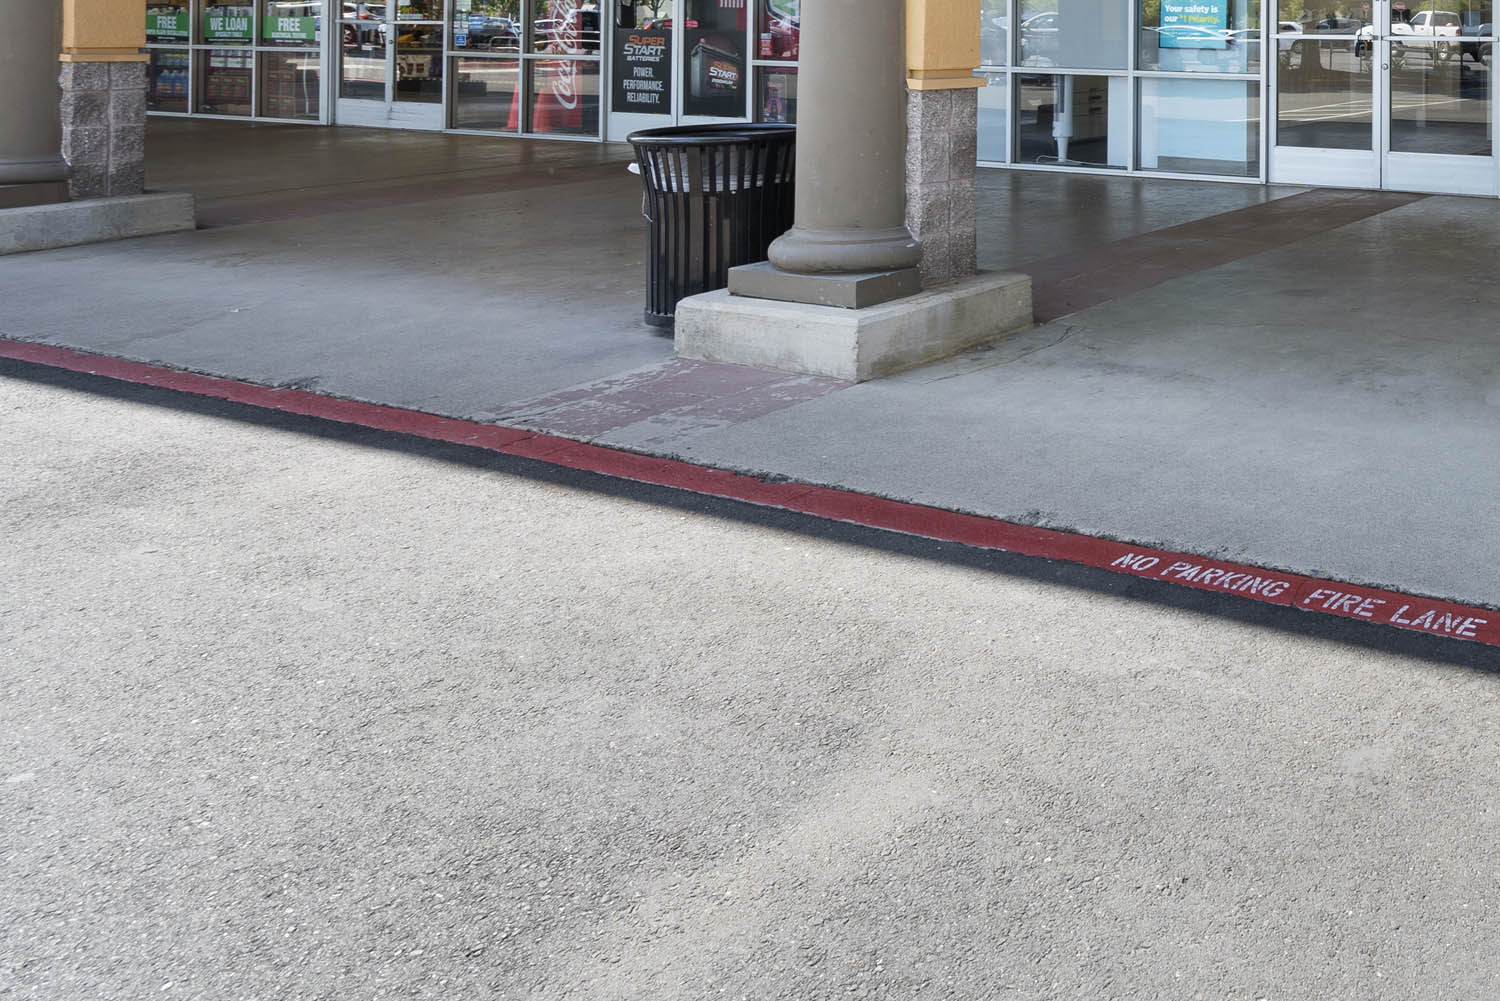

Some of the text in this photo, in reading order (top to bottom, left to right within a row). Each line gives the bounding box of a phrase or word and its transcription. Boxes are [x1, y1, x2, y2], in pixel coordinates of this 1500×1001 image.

[1165, 4, 1219, 14] Your safety is
[157, 15, 177, 29] FREE
[210, 17, 248, 31] WE LOAN
[278, 17, 301, 32] FREE
[1164, 15, 1178, 23] our
[628, 34, 665, 45] SUPER
[624, 43, 666, 55] START
[633, 66, 654, 78] POWER.
[709, 66, 737, 79] START
[623, 79, 665, 91] PERFORMANCE.
[626, 92, 660, 104] RELIABILITY.
[1111, 552, 1487, 637] NO PARKING FIRE LANE
